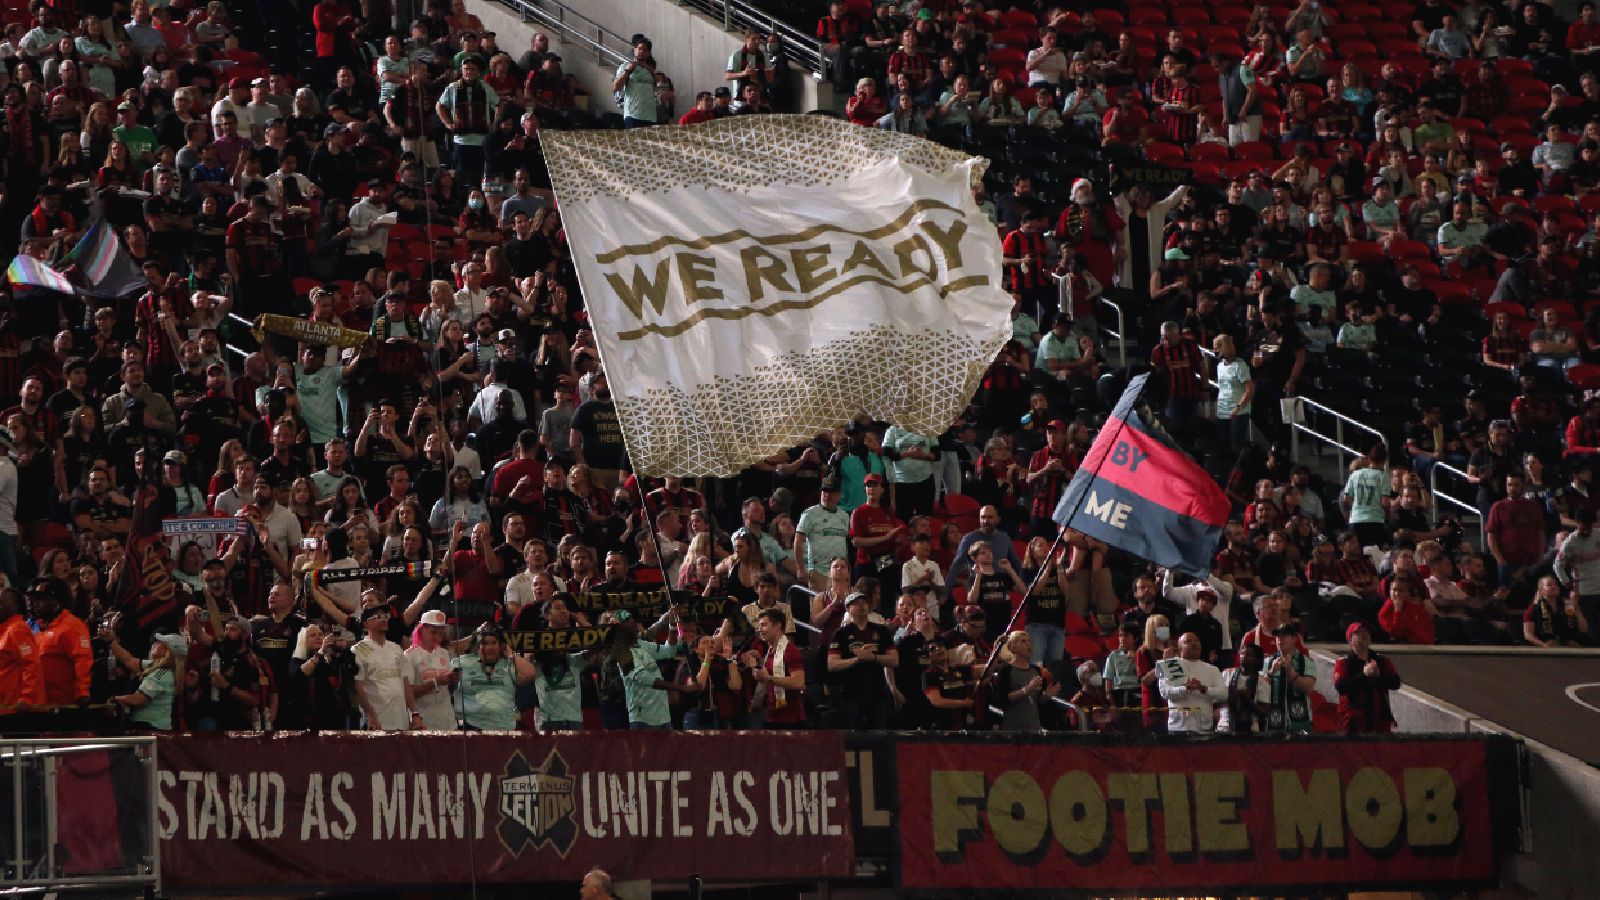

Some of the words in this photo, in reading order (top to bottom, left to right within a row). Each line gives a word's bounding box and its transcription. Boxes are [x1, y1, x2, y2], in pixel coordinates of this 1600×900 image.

[602, 252, 724, 320] WE
[740, 218, 968, 302] READY
[293, 320, 341, 337] ATLANTA
[1111, 441, 1148, 473] BY
[1084, 491, 1133, 530] ME
[1357, 484, 1377, 506] 17
[571, 592, 605, 608] WE
[503, 631, 535, 650] WE
[541, 627, 611, 650] READY
[504, 782, 571, 791] TERMINUS
[581, 771, 693, 838] UNITE
[706, 771, 758, 837] AS
[768, 770, 842, 836] ONE
[156, 770, 285, 840] STAND
[300, 771, 357, 840] AS
[371, 771, 491, 840] MANY
[502, 793, 573, 837] LEGION
[930, 769, 1253, 862] FOOTIE
[1272, 766, 1465, 858] MOB
